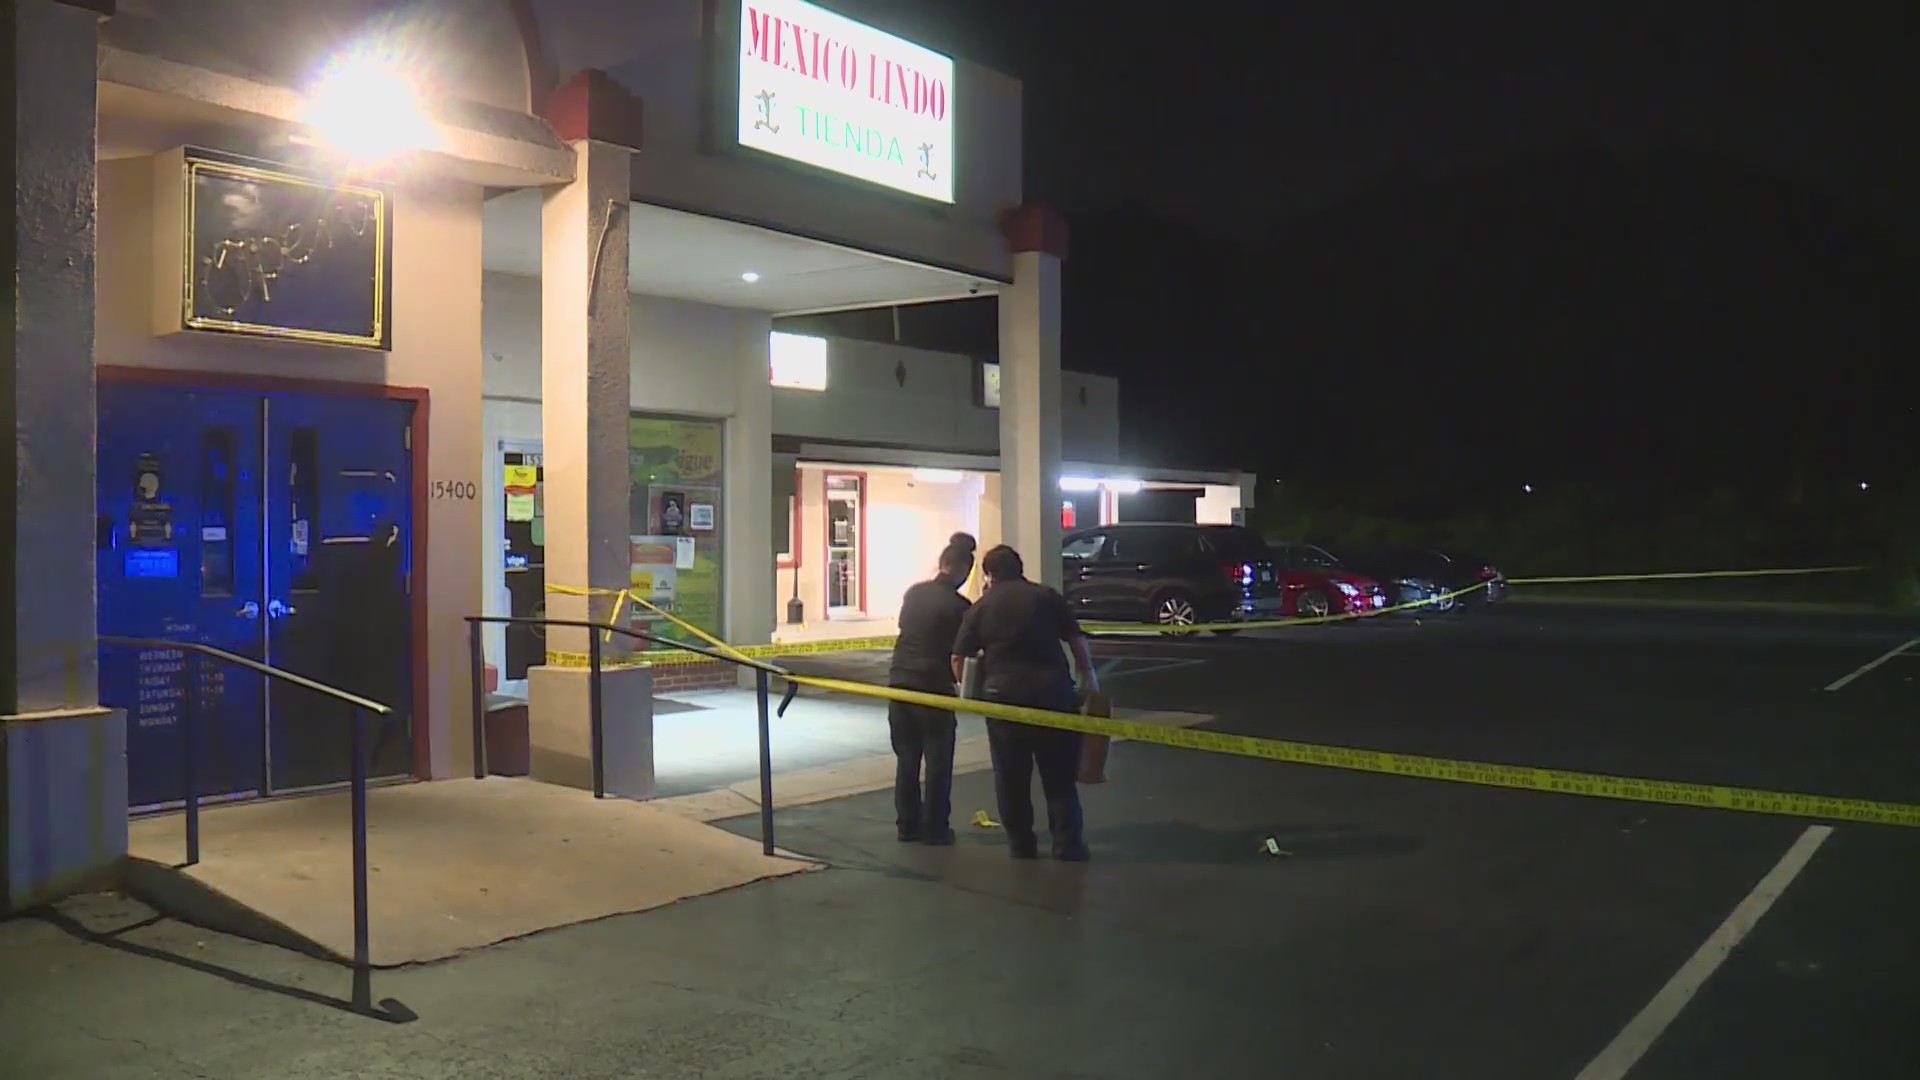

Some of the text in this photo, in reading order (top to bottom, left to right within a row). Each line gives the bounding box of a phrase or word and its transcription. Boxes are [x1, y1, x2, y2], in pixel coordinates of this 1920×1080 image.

[748, 7, 945, 121] MEXICO LINDO
[795, 105, 904, 165] TIENDA
[431, 480, 476, 500] 15400
